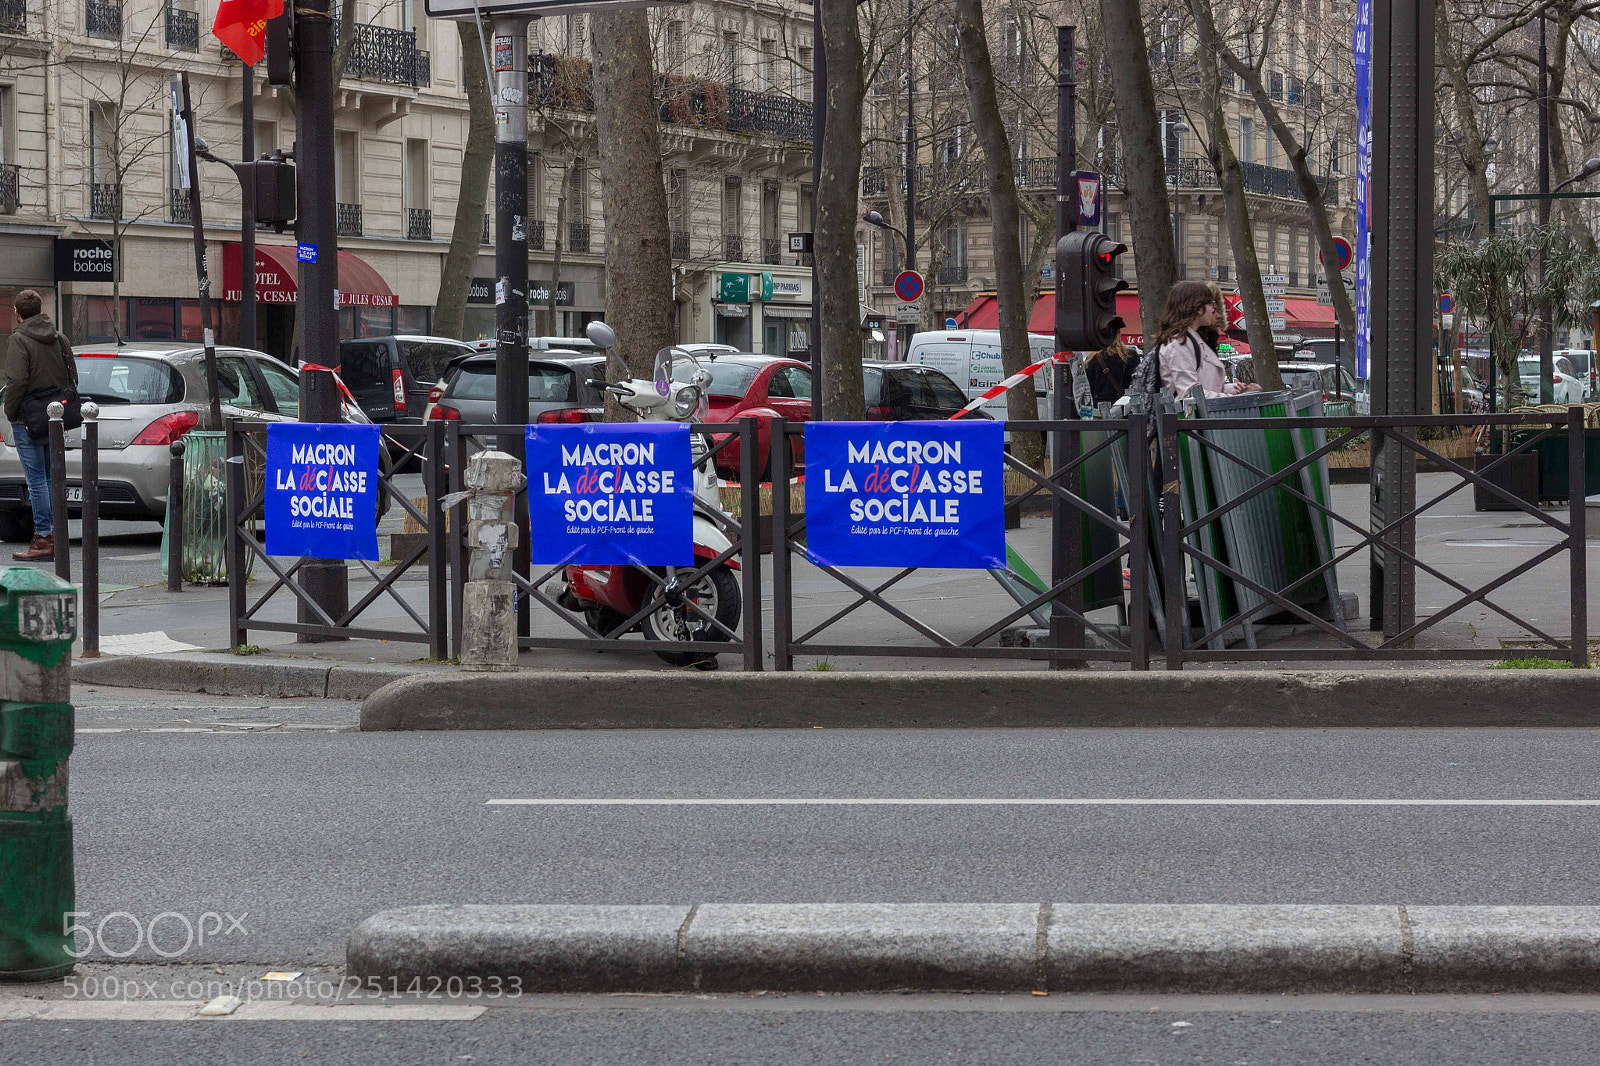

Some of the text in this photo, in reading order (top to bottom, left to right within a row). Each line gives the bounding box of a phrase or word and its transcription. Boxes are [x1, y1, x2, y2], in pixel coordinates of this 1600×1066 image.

[73, 247, 113, 259] roche
[73, 260, 113, 272] bobois
[255, 273, 281, 285] TEL
[348, 293, 369, 305] JULES
[371, 294, 393, 306] CESAR
[529, 286, 549, 300] roche
[980, 351, 1002, 360] Chub
[292, 443, 355, 466] MACRON
[561, 442, 655, 466] MACRON
[848, 440, 961, 464] MACRON
[276, 469, 296, 490] LA
[543, 472, 571, 494] LA
[824, 469, 858, 493] LA
[868, 528, 881, 536] par
[882, 525, 888, 535] le
[889, 526, 922, 536] PCF-Front
[923, 526, 933, 536] de
[934, 526, 959, 537] gauche
